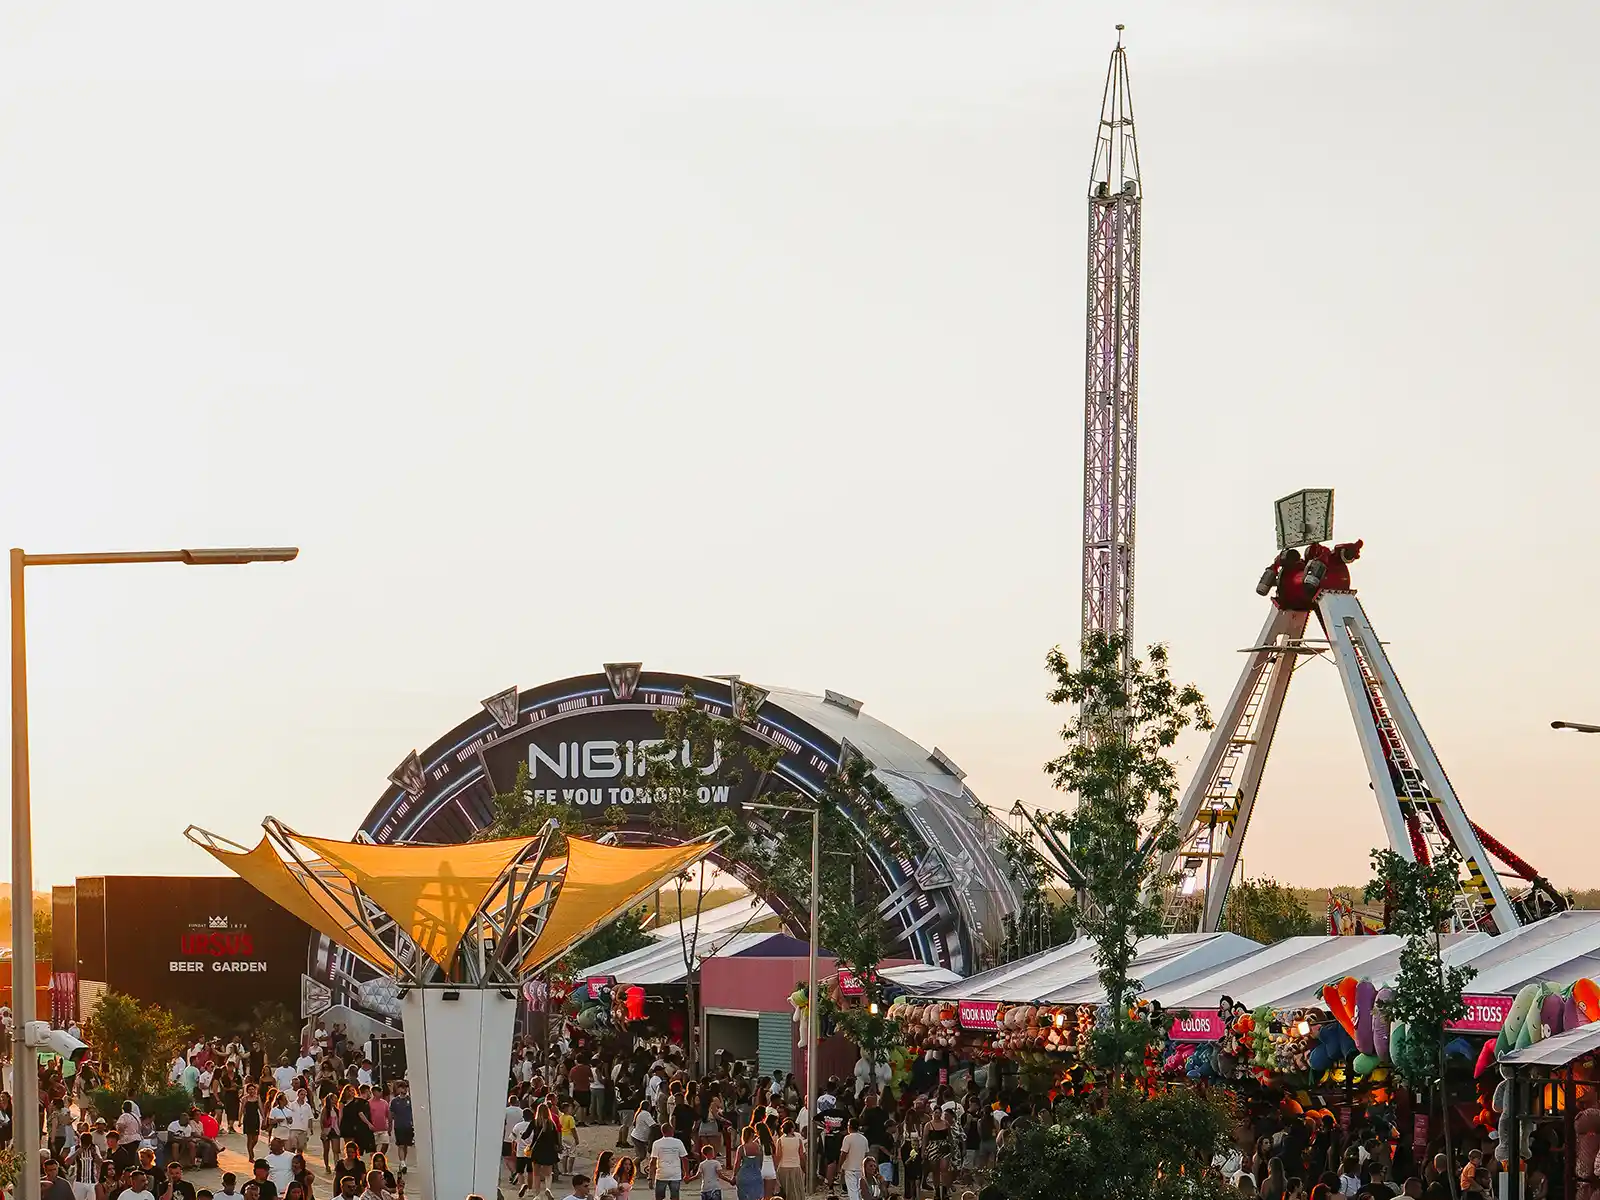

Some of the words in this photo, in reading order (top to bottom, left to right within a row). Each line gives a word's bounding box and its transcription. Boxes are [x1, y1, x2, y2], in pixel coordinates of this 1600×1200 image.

[523, 789, 557, 805] SEE
[563, 788, 603, 805] YOU
[181, 932, 254, 957] URSUS
[169, 961, 204, 972] BEER
[212, 961, 268, 972] GARDEN
[961, 1008, 980, 1021] HOOK
[1476, 1005, 1502, 1022] TOSS
[1180, 1018, 1211, 1032] COLORS
